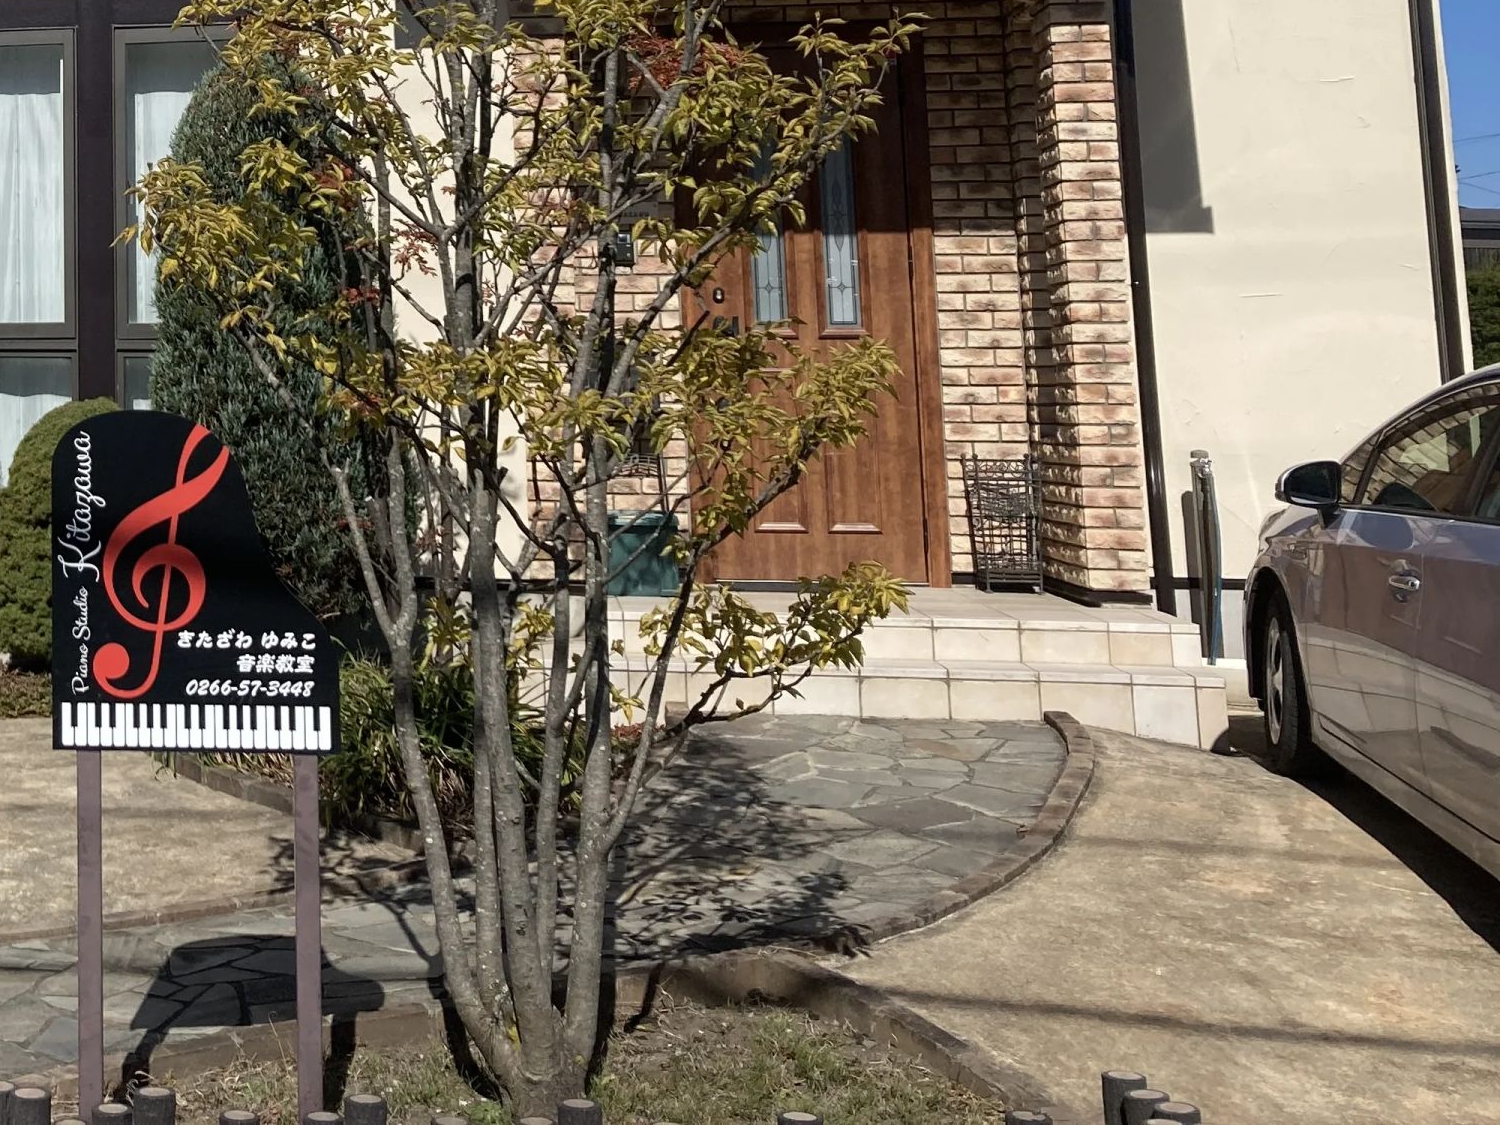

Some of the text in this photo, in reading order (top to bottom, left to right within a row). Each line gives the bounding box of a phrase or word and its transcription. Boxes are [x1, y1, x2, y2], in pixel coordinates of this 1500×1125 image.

[57, 430, 106, 696] Piano Studio Kitazawa
[177, 627, 316, 650] きたざわ ゆみこ
[236, 653, 315, 674] 音楽教室
[185, 679, 315, 697] 0266-57-3448
